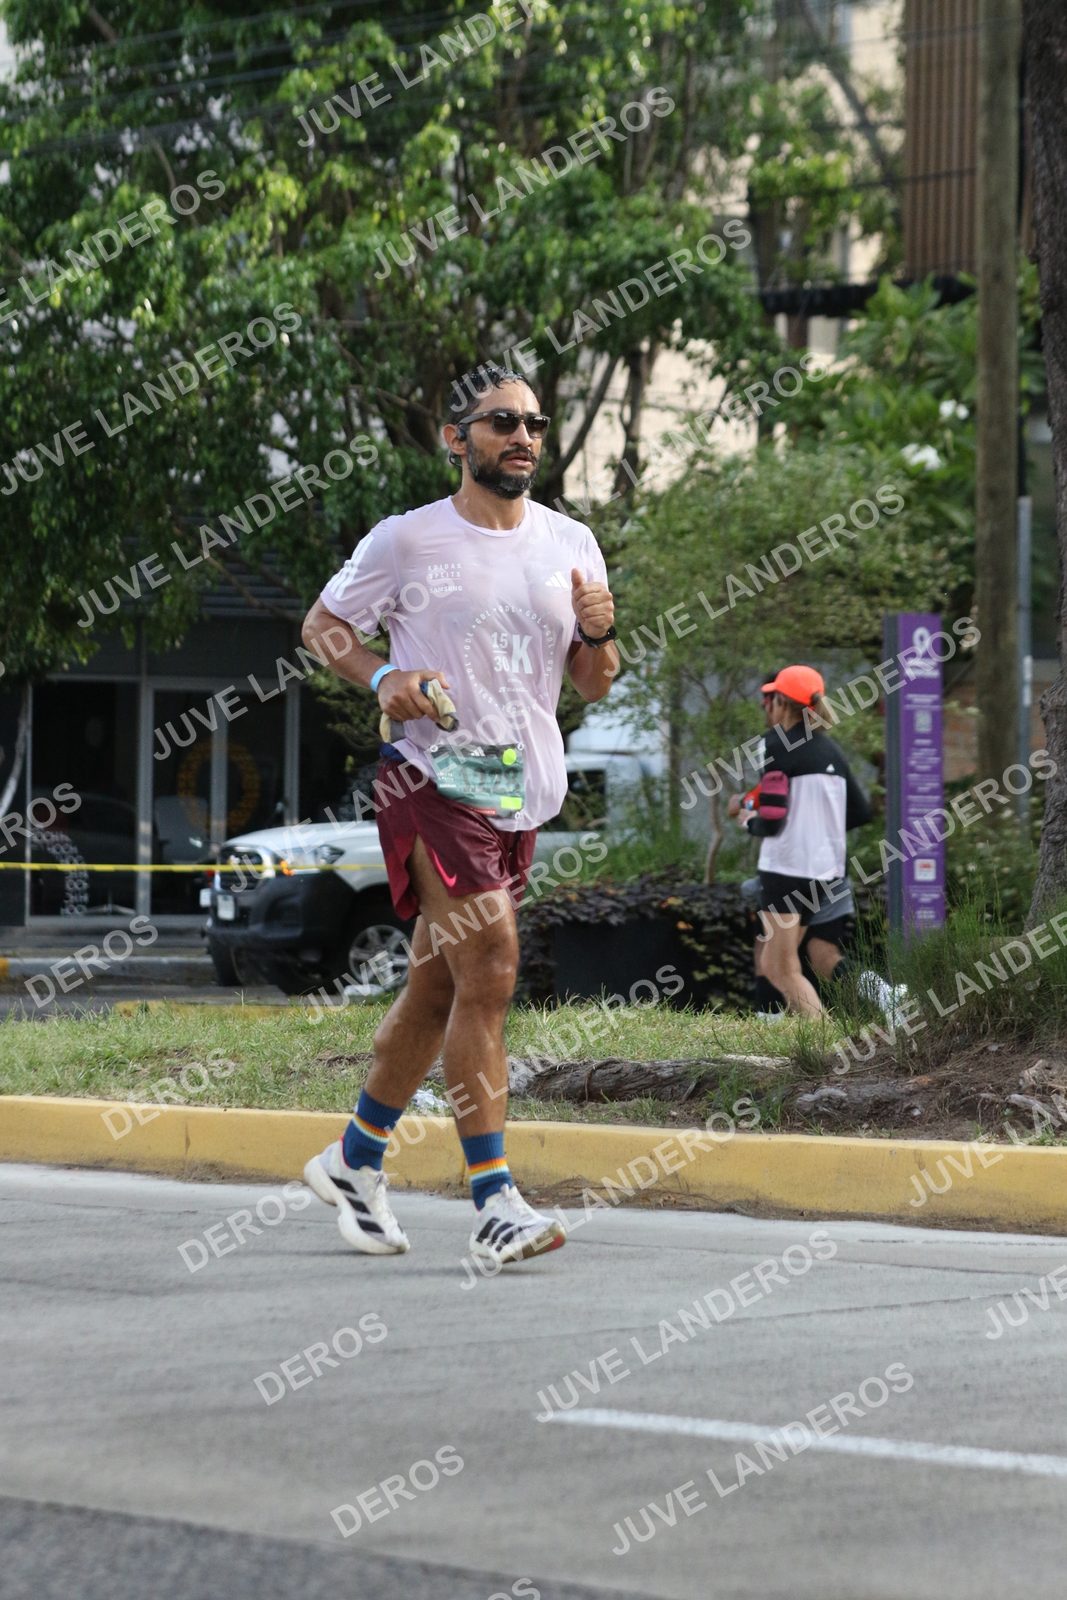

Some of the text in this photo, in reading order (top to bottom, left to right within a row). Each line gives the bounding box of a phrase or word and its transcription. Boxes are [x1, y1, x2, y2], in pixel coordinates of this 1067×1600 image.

[490, 632, 508, 649] 15
[511, 634, 534, 674] K
[494, 655, 510, 672] 30
